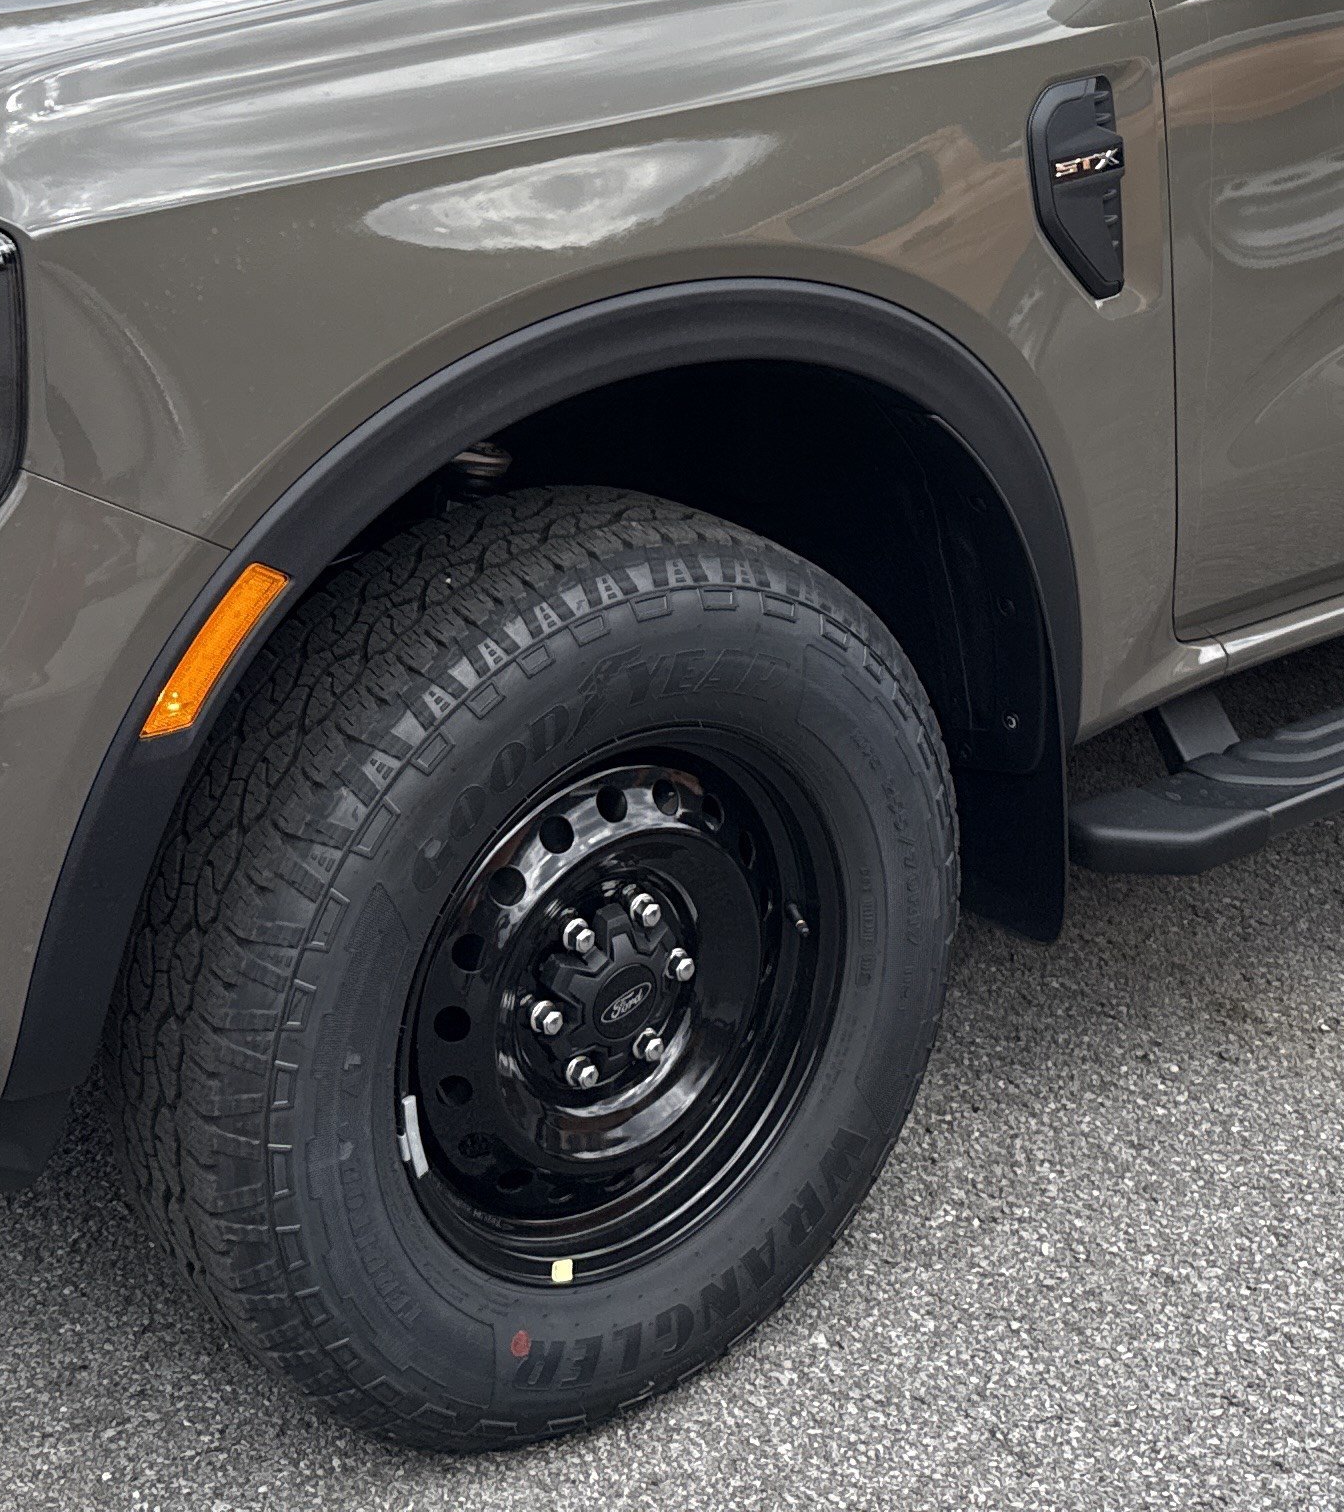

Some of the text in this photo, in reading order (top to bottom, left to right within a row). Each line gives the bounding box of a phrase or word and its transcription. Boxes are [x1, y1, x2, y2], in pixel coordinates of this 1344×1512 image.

[1055, 147, 1120, 178] STX
[610, 988, 644, 1019] Ford
[512, 1127, 872, 1391] WRANGLER
